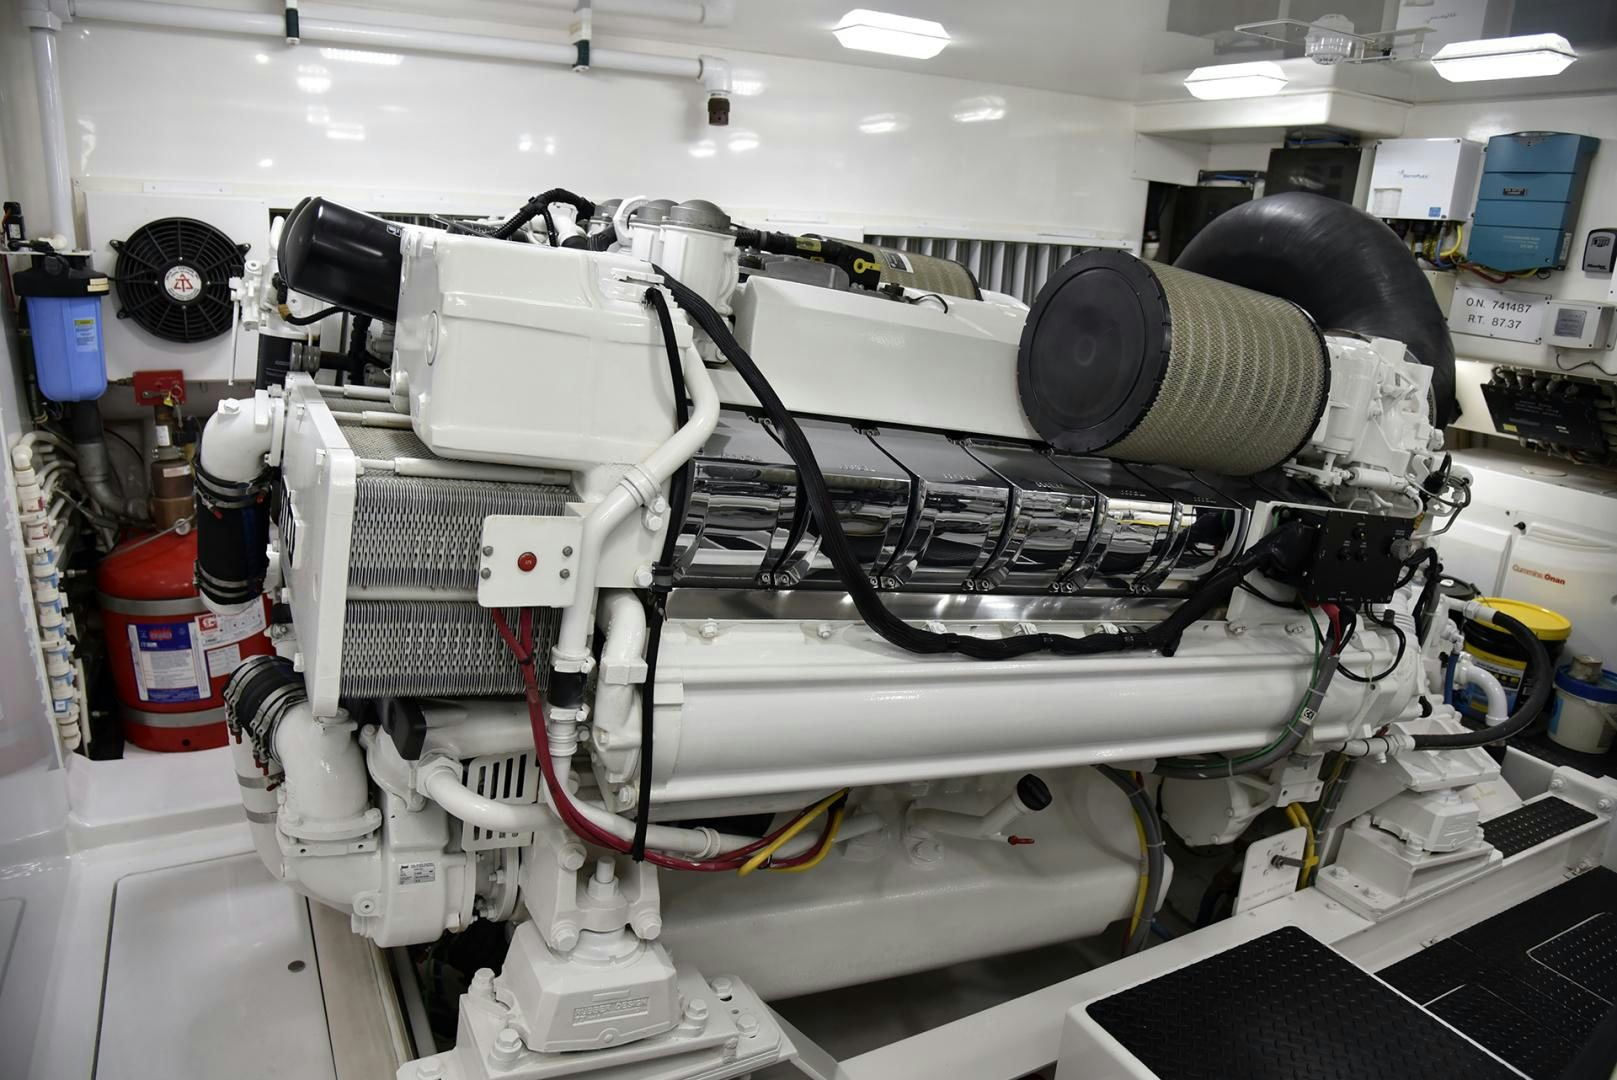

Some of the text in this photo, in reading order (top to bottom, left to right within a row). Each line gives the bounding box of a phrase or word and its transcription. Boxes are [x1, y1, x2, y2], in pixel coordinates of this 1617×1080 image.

[1492, 300, 1532, 313] 741487
[1491, 317, 1522, 329] 87.37
[1512, 564, 1566, 585] Cummins Onan
